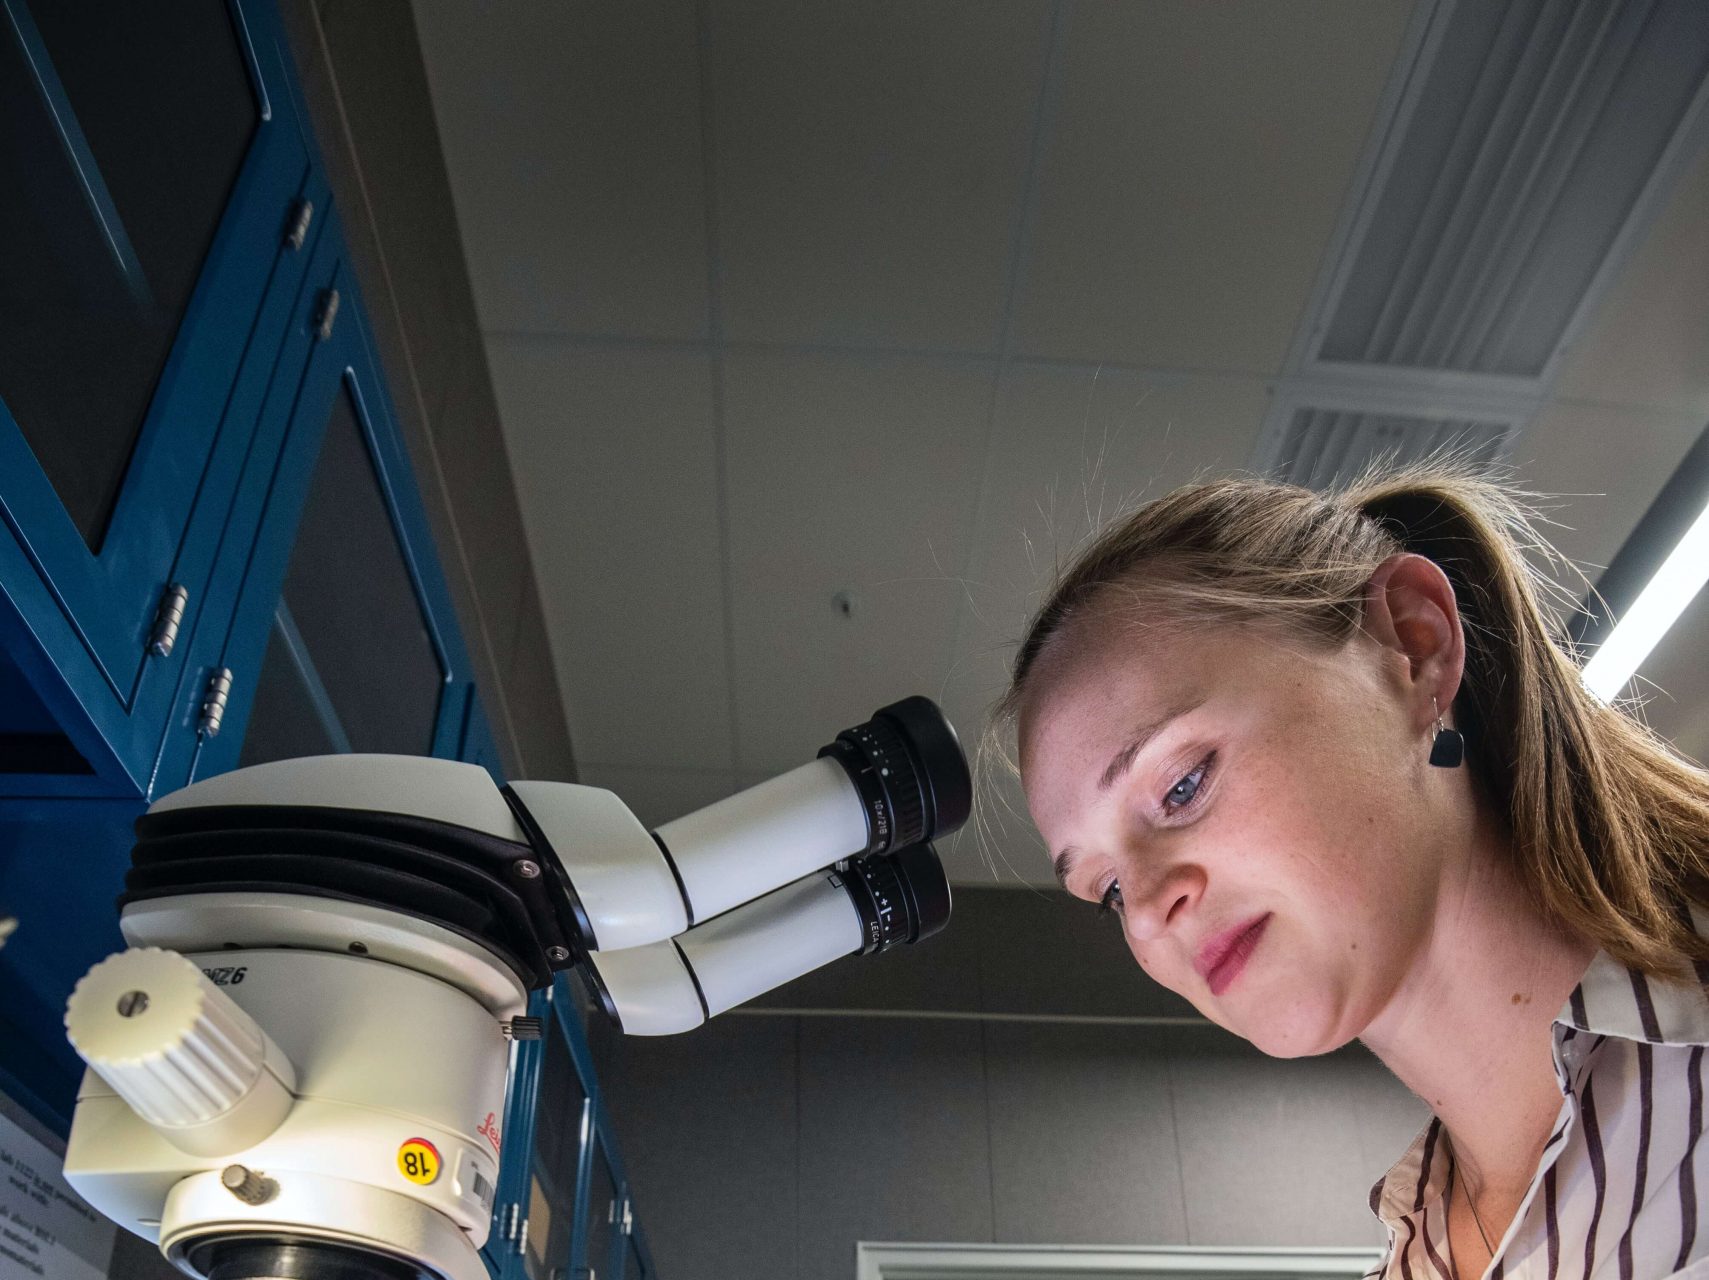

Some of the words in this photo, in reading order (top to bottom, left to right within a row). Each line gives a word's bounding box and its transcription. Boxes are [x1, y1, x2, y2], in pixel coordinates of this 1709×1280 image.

[870, 921, 880, 942] LEICA
[476, 1112, 501, 1156] Lei
[404, 1151, 430, 1177] 18
